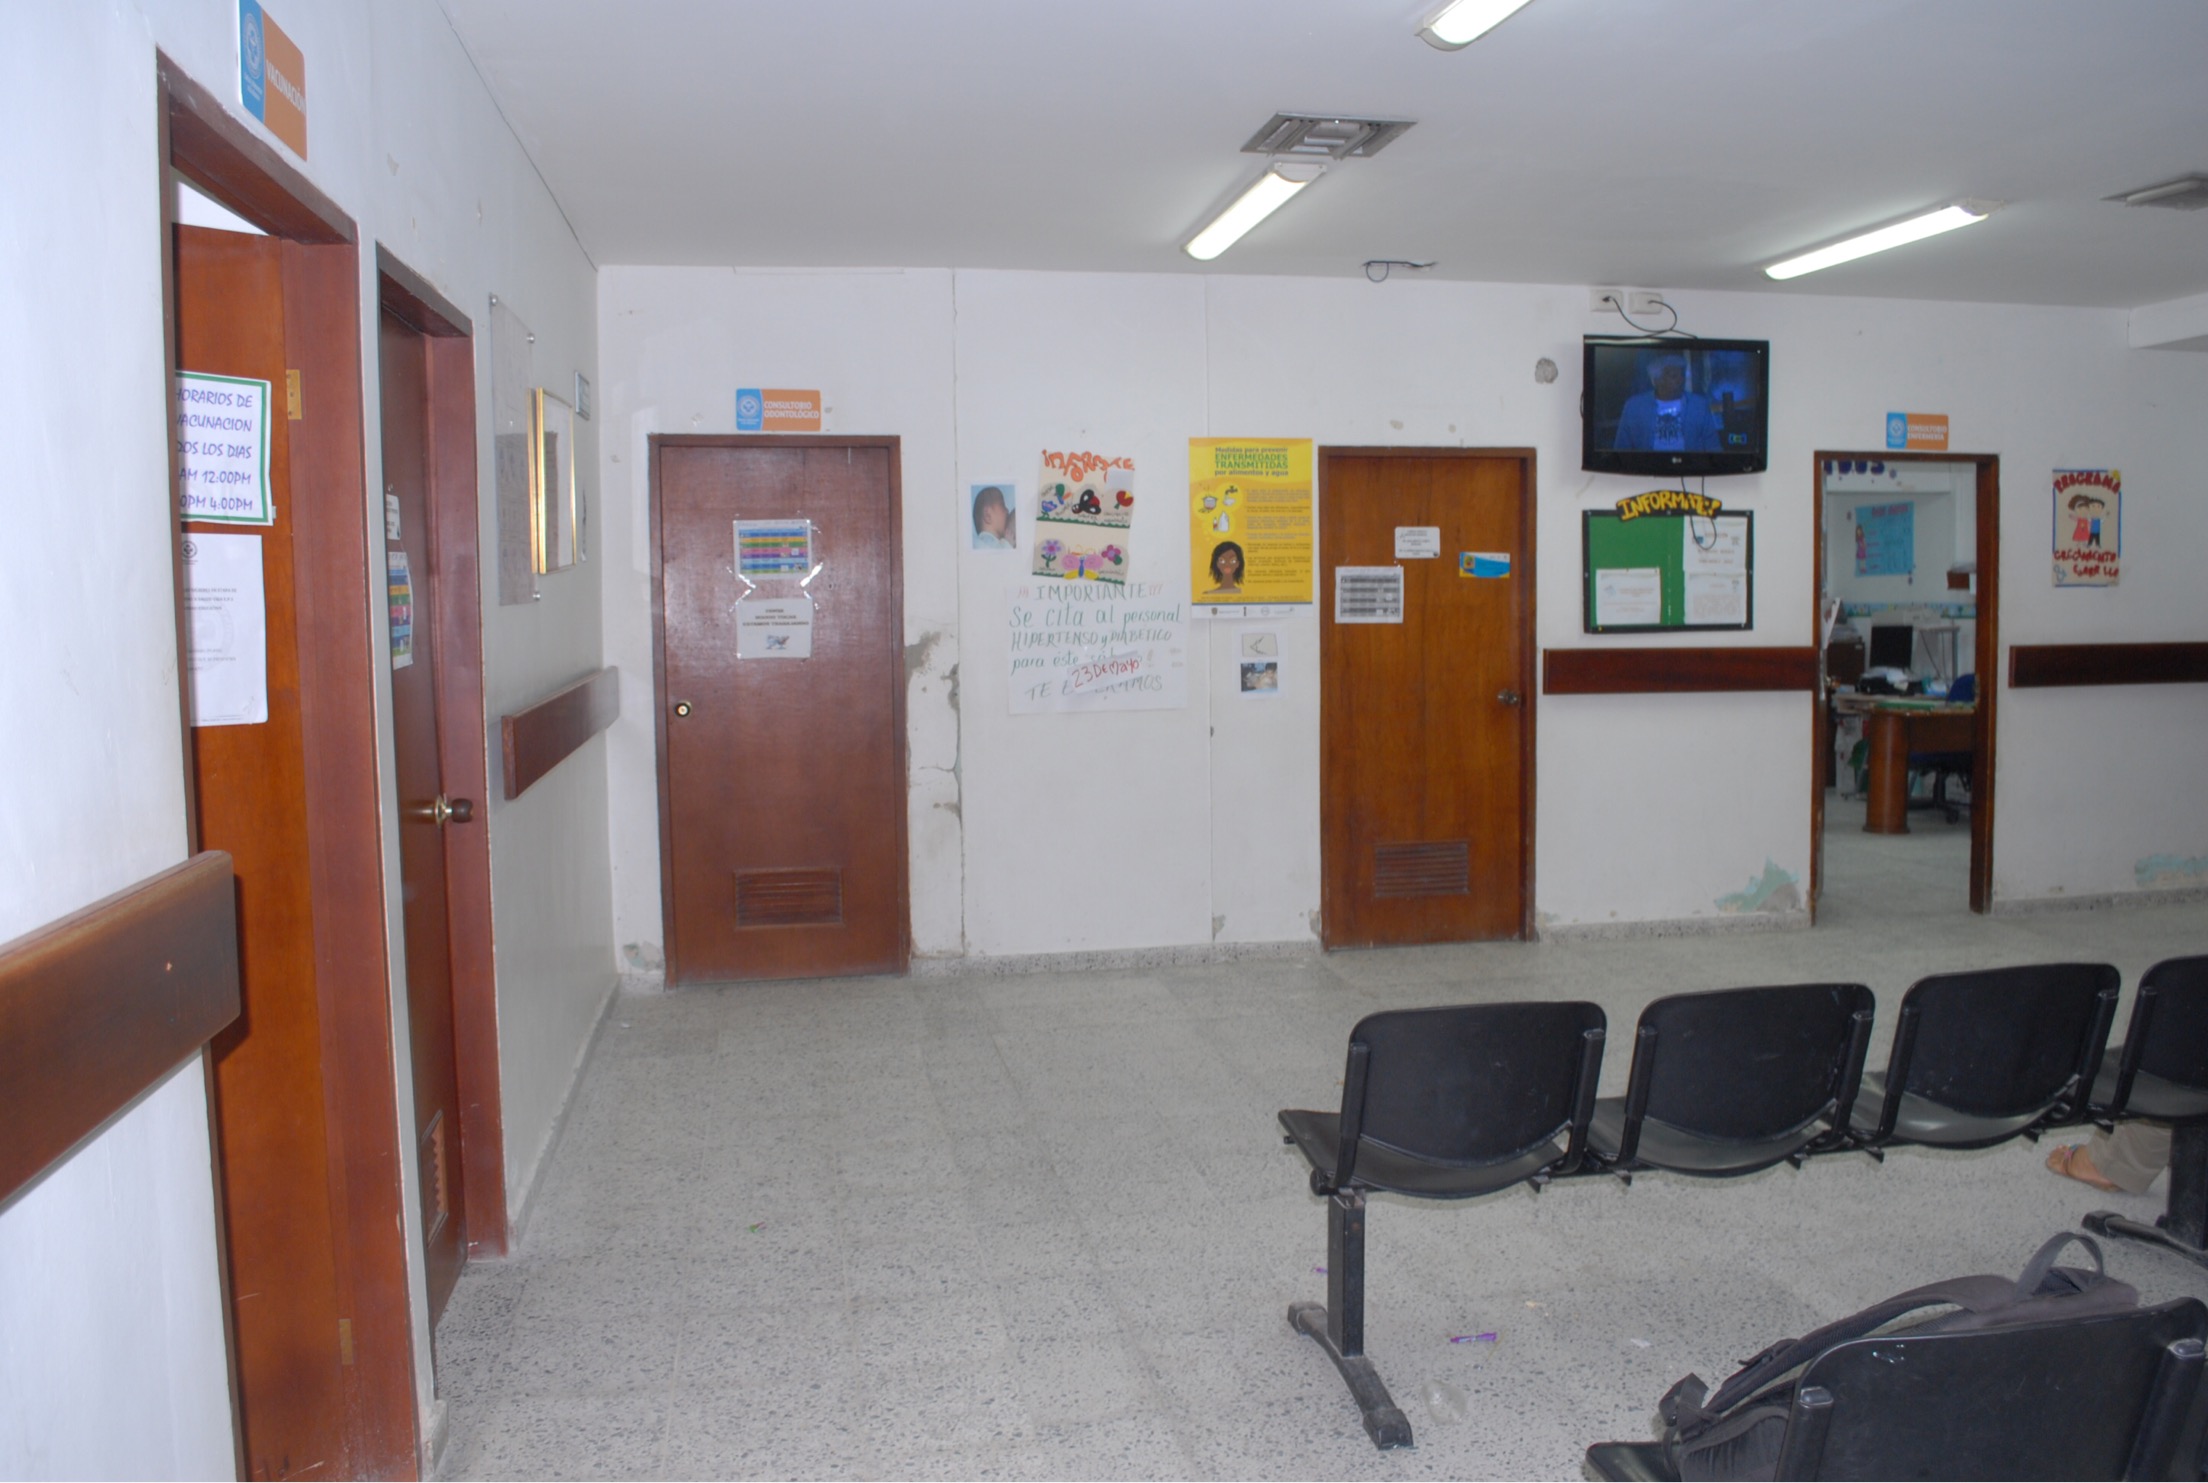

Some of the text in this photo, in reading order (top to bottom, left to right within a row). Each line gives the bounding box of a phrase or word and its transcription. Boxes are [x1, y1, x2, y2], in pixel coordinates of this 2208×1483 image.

[177, 388, 253, 408] HORARIOS DE
[763, 401, 813, 410] CONSULTORIO
[763, 410, 820, 419] ODONTOLÓGICO
[1906, 424, 1948, 433] CONSULTORIO
[202, 442, 223, 456] LOS
[227, 444, 252, 459] DIAS
[1215, 453, 1289, 461] ENFERMEDADES
[1215, 461, 1289, 469] TRANSMITIDAS
[1215, 469, 1227, 477] por
[179, 467, 251, 485] AM 12:00PM
[2054, 471, 2122, 495] PROGRAMA
[210, 497, 253, 511] 4:00PM
[1034, 583, 1147, 602] IMPORTANTE
[1009, 602, 1183, 630] Se cita al personal
[1011, 630, 1099, 651] HIPERTENSO
[1010, 656, 1045, 677] para
[1025, 681, 1052, 701] TE
